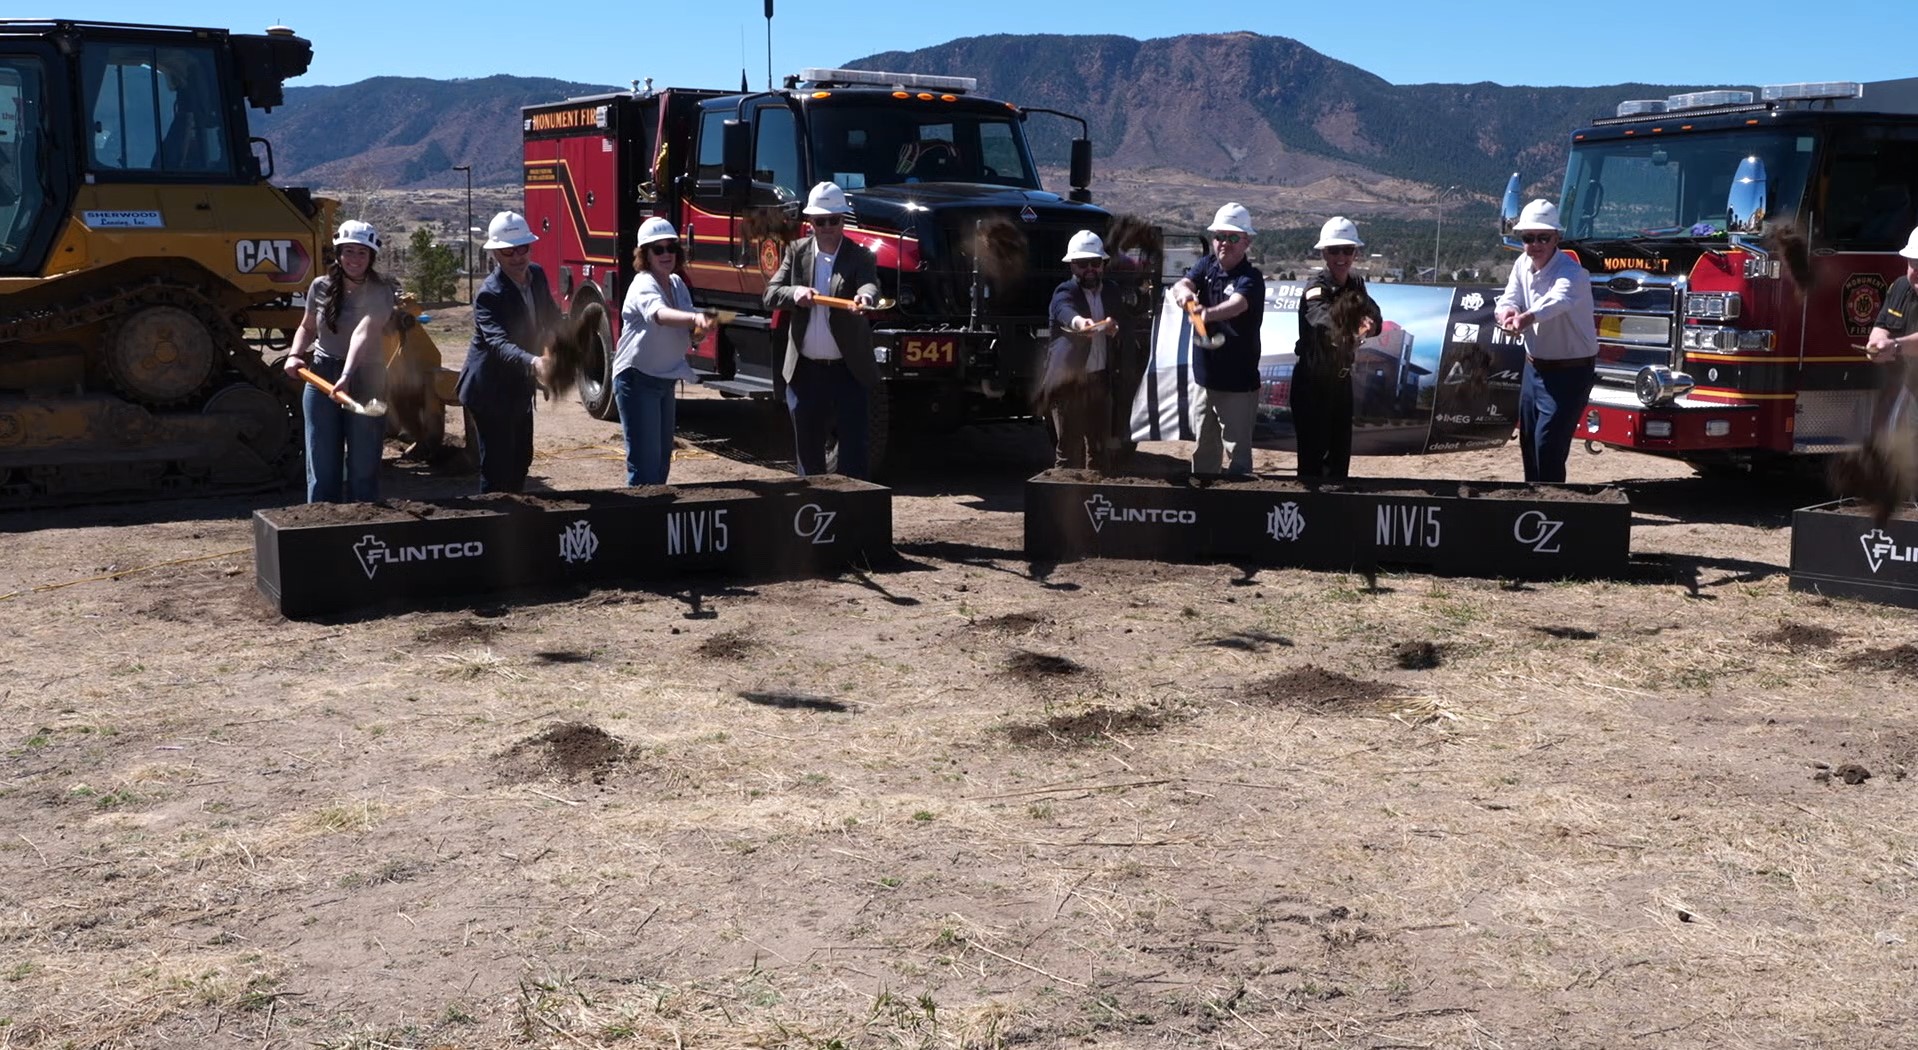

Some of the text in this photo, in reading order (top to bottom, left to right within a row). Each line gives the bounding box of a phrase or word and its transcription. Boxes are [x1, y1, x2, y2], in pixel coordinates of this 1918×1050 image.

[532, 107, 597, 130] MONUMENT FIR
[236, 240, 291, 273] CAT
[1278, 285, 1303, 297] Dis
[1846, 277, 1885, 289] MONUMENT
[1274, 298, 1300, 310] Stat
[905, 341, 954, 362] 541
[1443, 413, 1471, 424] IMEG
[1094, 506, 1197, 524] FLINTCO
[366, 541, 484, 565] FLINTCO
